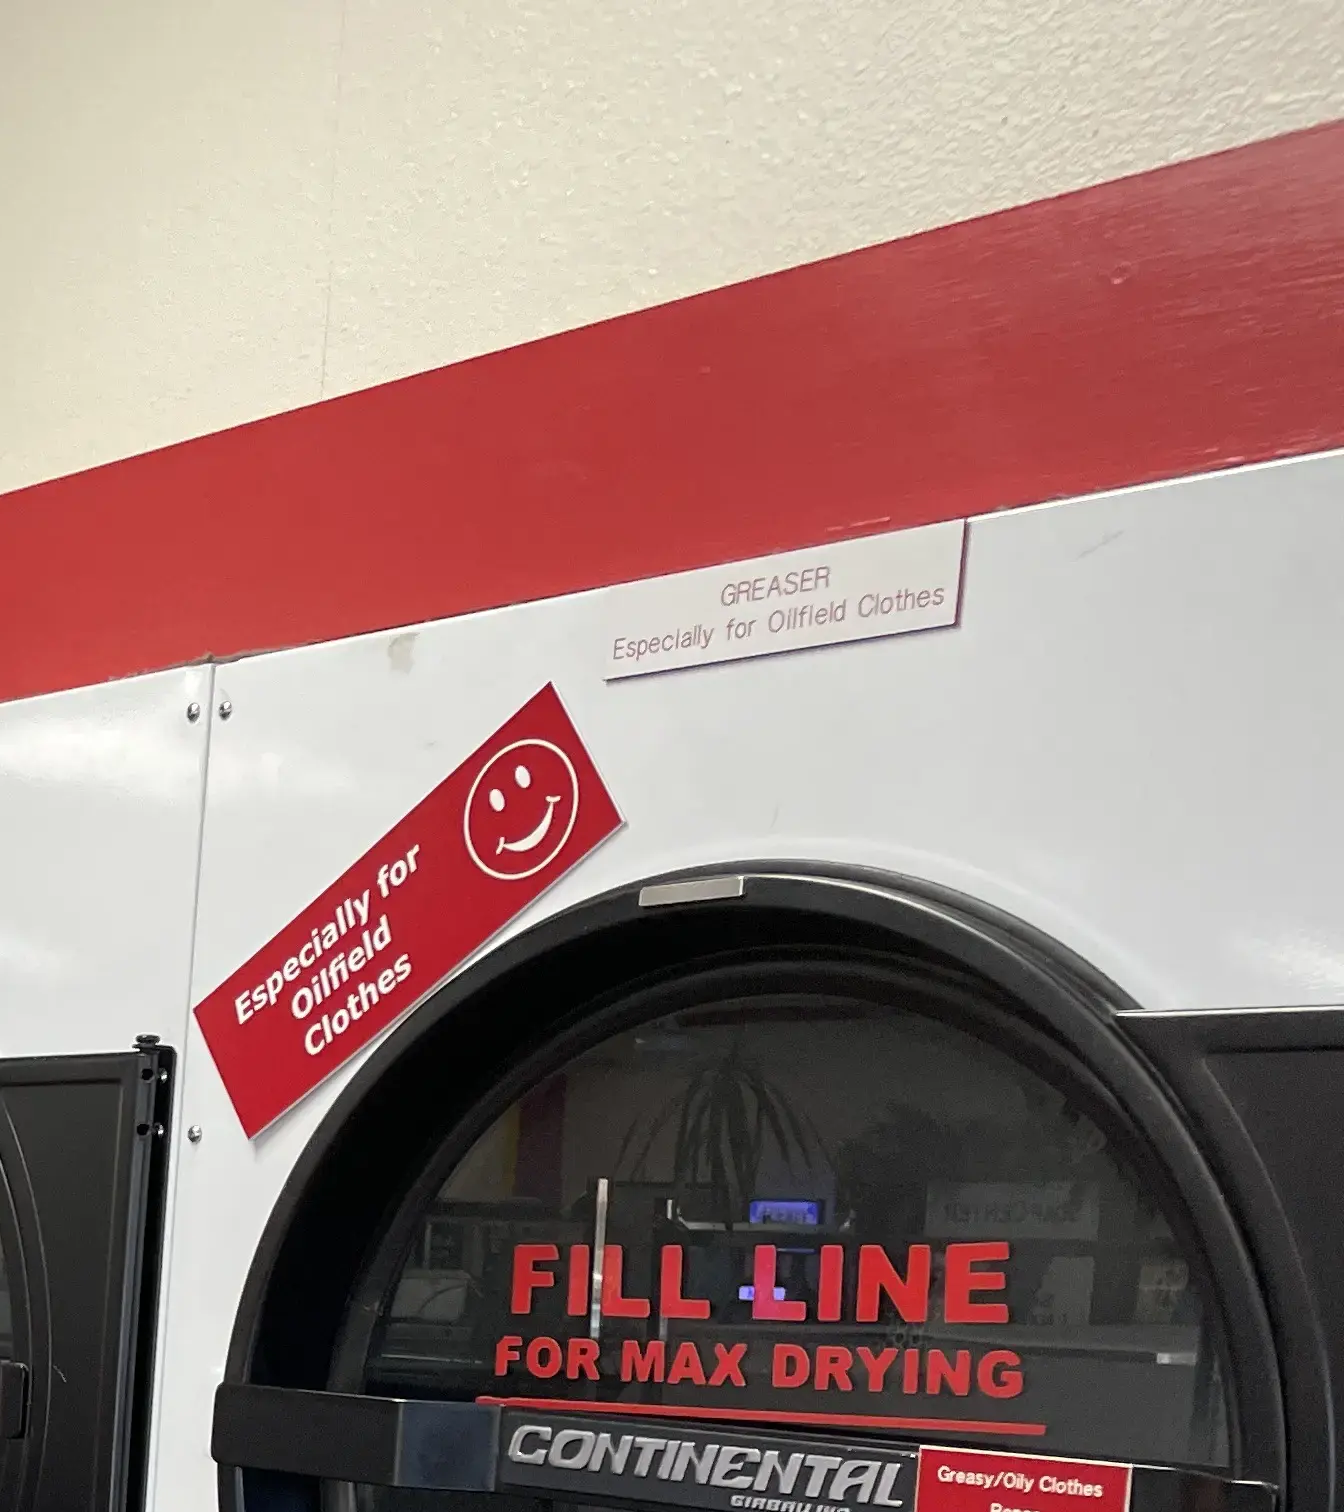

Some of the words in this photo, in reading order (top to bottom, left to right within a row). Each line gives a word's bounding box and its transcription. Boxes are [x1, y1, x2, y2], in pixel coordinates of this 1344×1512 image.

[611, 622, 715, 664] Especially
[724, 613, 759, 643] for
[766, 599, 848, 637] Oilfield
[856, 583, 947, 621] Clothes
[719, 564, 832, 609] GREASER
[233, 894, 376, 1029] Especially
[372, 839, 424, 904] for
[288, 912, 395, 1023] Oilfield
[302, 951, 415, 1061] Clothes
[509, 1242, 710, 1320] FILL
[749, 1240, 1011, 1325] LINE
[493, 1335, 603, 1382] FOR
[620, 1342, 749, 1389] MAX
[770, 1345, 1025, 1400] DRYING
[508, 1424, 904, 1509] CONTINENTAL
[935, 1464, 1036, 1495] Greasy/Oily
[1038, 1473, 1104, 1499] Clothes
